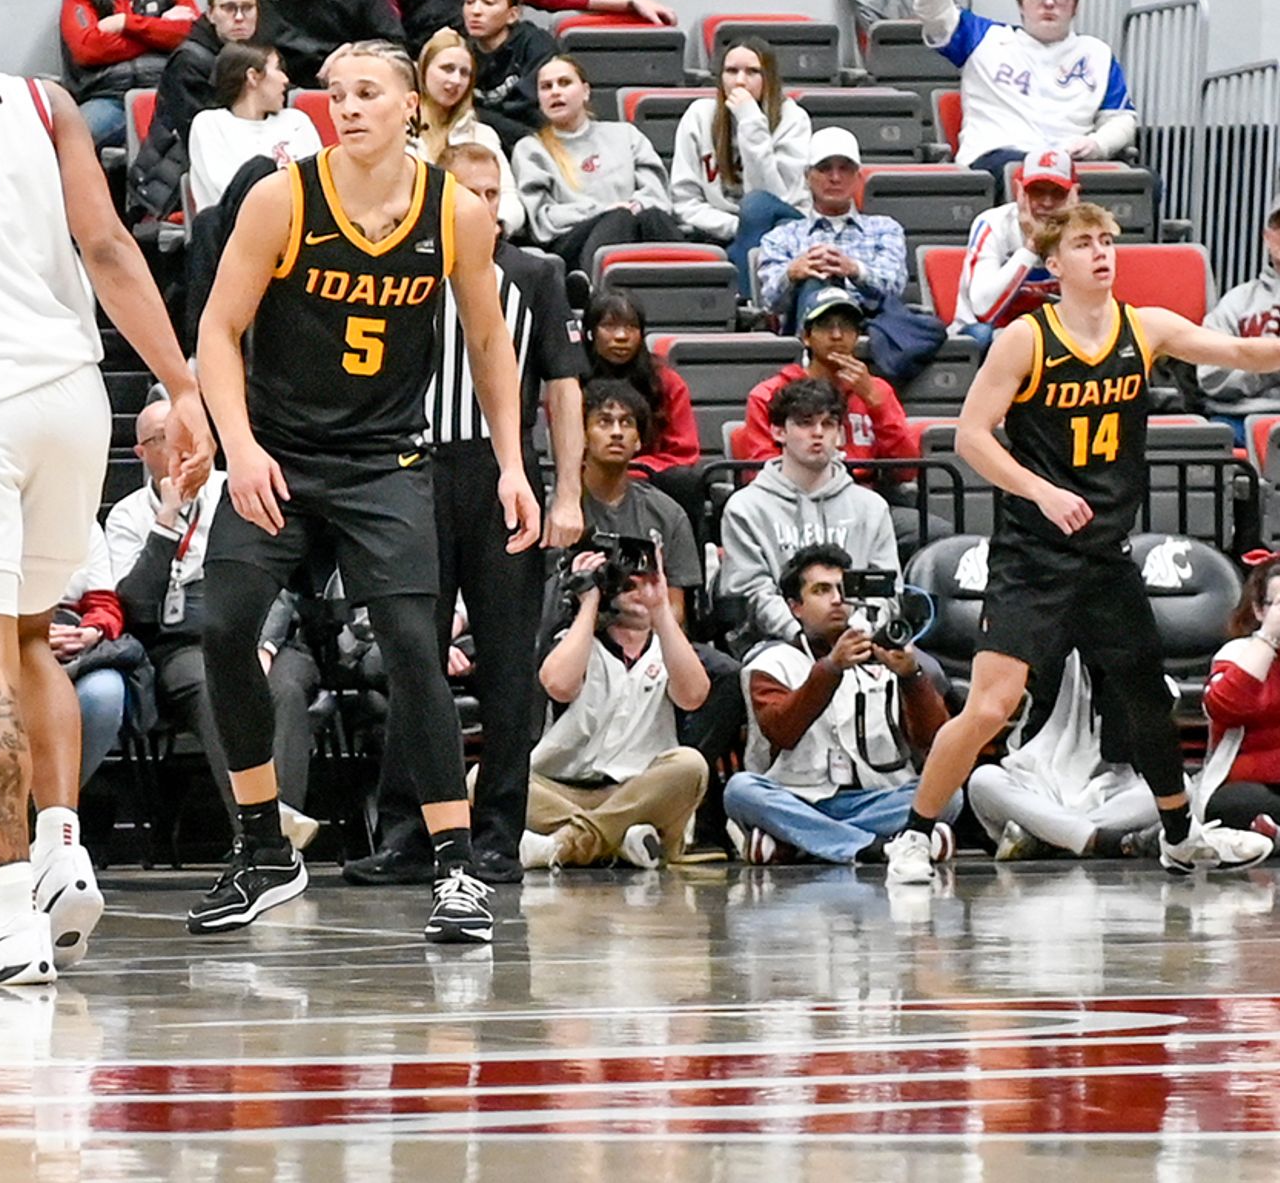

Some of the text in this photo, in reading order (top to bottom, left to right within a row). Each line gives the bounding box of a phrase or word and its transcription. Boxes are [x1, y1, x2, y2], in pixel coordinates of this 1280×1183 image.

[993, 62, 1031, 96] 24
[305, 267, 436, 307] IDAHO
[341, 316, 387, 377] 5
[1044, 373, 1142, 409] IDAHO
[1070, 412, 1120, 467] 14
